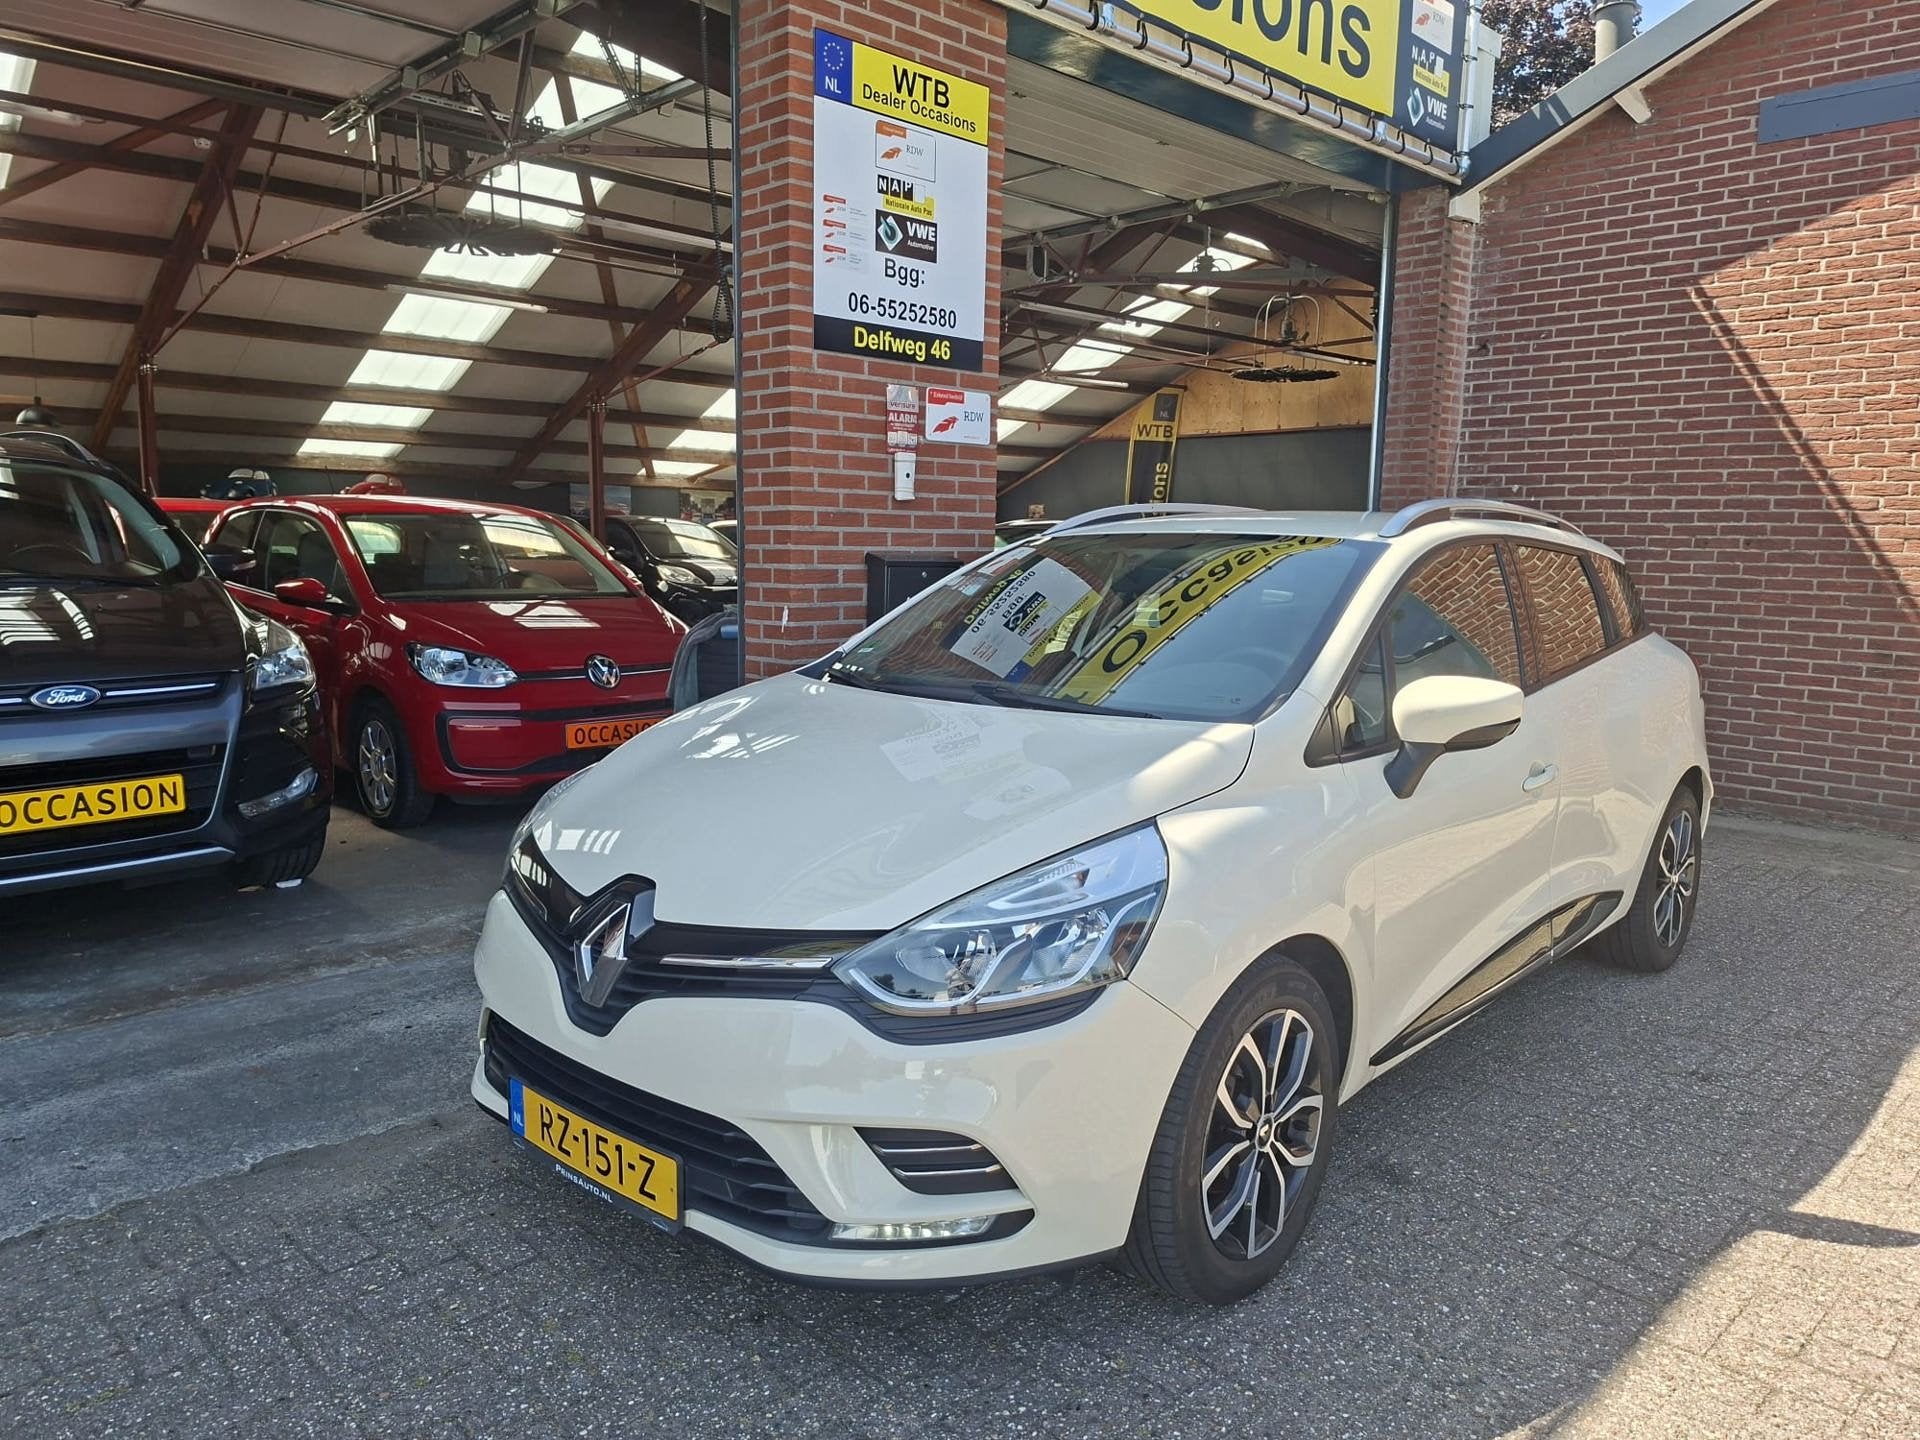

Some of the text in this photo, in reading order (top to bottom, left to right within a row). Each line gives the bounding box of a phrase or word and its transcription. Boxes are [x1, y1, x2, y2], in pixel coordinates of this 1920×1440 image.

[1191, 0, 1371, 79] ons
[825, 75, 842, 95] NL
[892, 64, 950, 109] WTB
[862, 82, 977, 133] Dealer Occasions
[1426, 95, 1448, 120] VWE
[906, 144, 924, 157] RDW
[905, 221, 937, 243] VWE
[907, 239, 936, 252] Automotive
[884, 257, 926, 289] Bgg:
[848, 291, 957, 330] 06-55252580
[854, 326, 951, 362] Delfweg 46
[888, 411, 917, 424] ALARM
[963, 410, 984, 423] RDW
[1137, 423, 1174, 438] WTB
[45, 688, 87, 706] Ford
[0, 780, 181, 830] OCCASION
[512, 1110, 524, 1127] NL
[539, 1103, 657, 1201] RZ-151-Z
